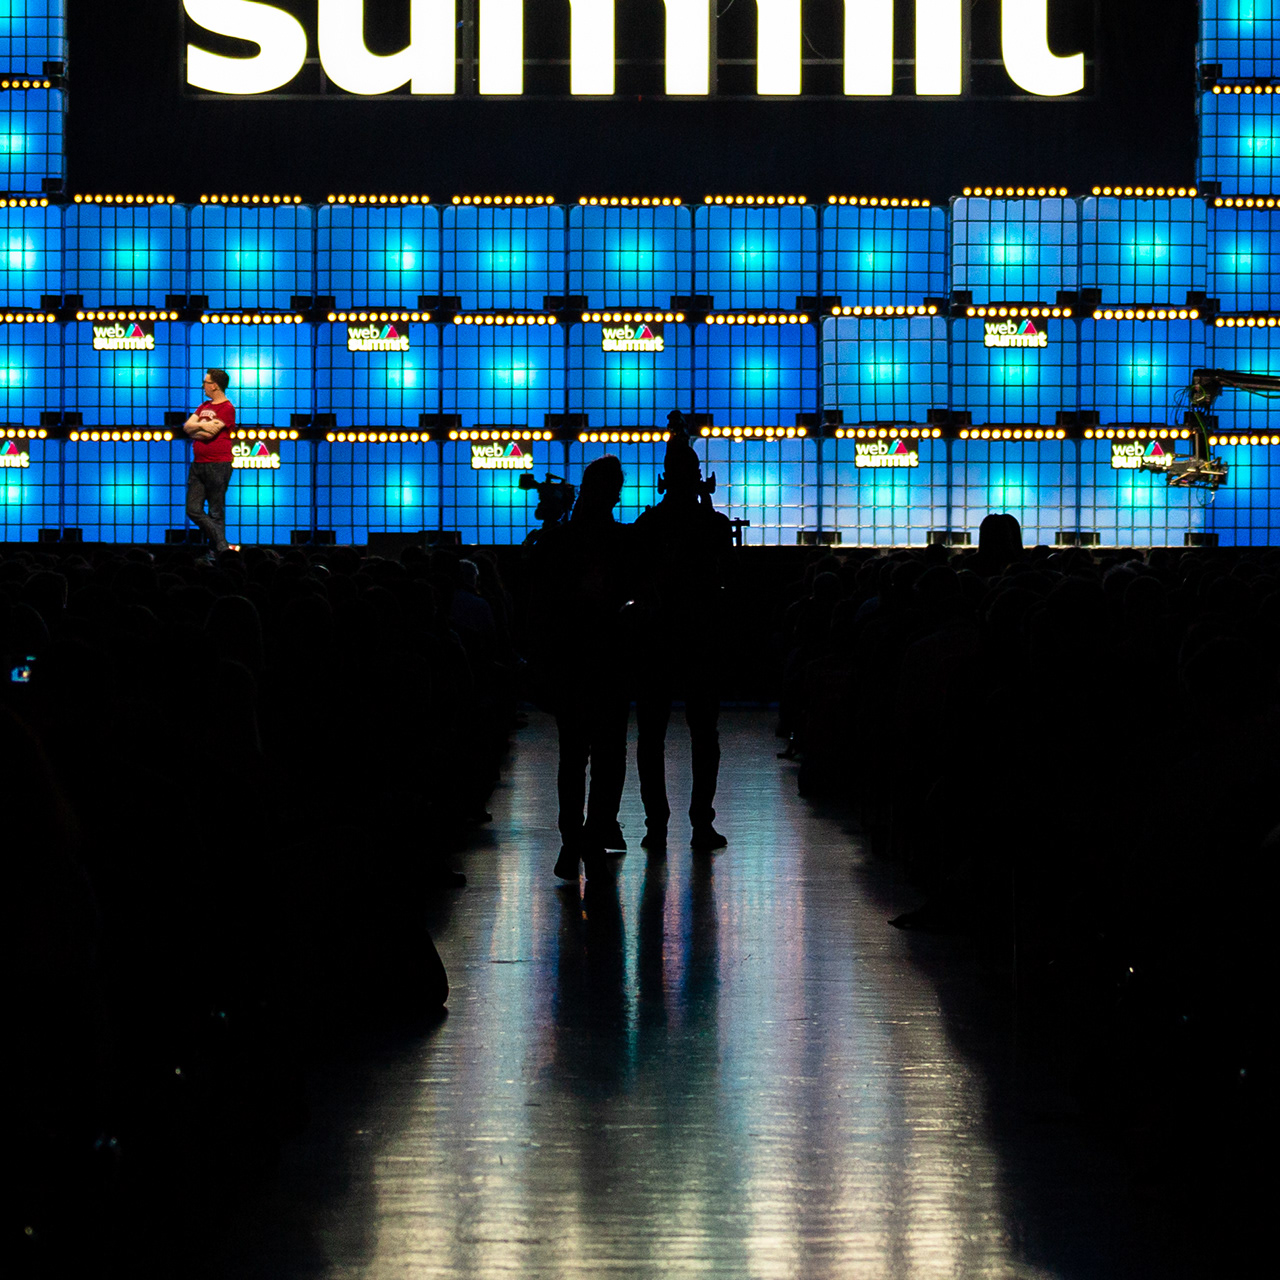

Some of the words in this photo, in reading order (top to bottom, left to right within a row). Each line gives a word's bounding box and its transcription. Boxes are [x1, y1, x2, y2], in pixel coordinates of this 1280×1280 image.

[93, 323, 125, 337] web
[348, 324, 380, 339] web
[602, 324, 635, 339] web
[985, 320, 1017, 334] web
[93, 334, 155, 350] summit
[348, 335, 410, 351] summit
[602, 336, 664, 351] summit
[984, 331, 1047, 347] summit
[231, 442, 250, 456] eb
[472, 442, 503, 457] web
[855, 440, 888, 455] web
[1112, 441, 1145, 456] web
[231, 453, 280, 469] ummit
[471, 453, 533, 469] summit
[855, 451, 918, 467] summit
